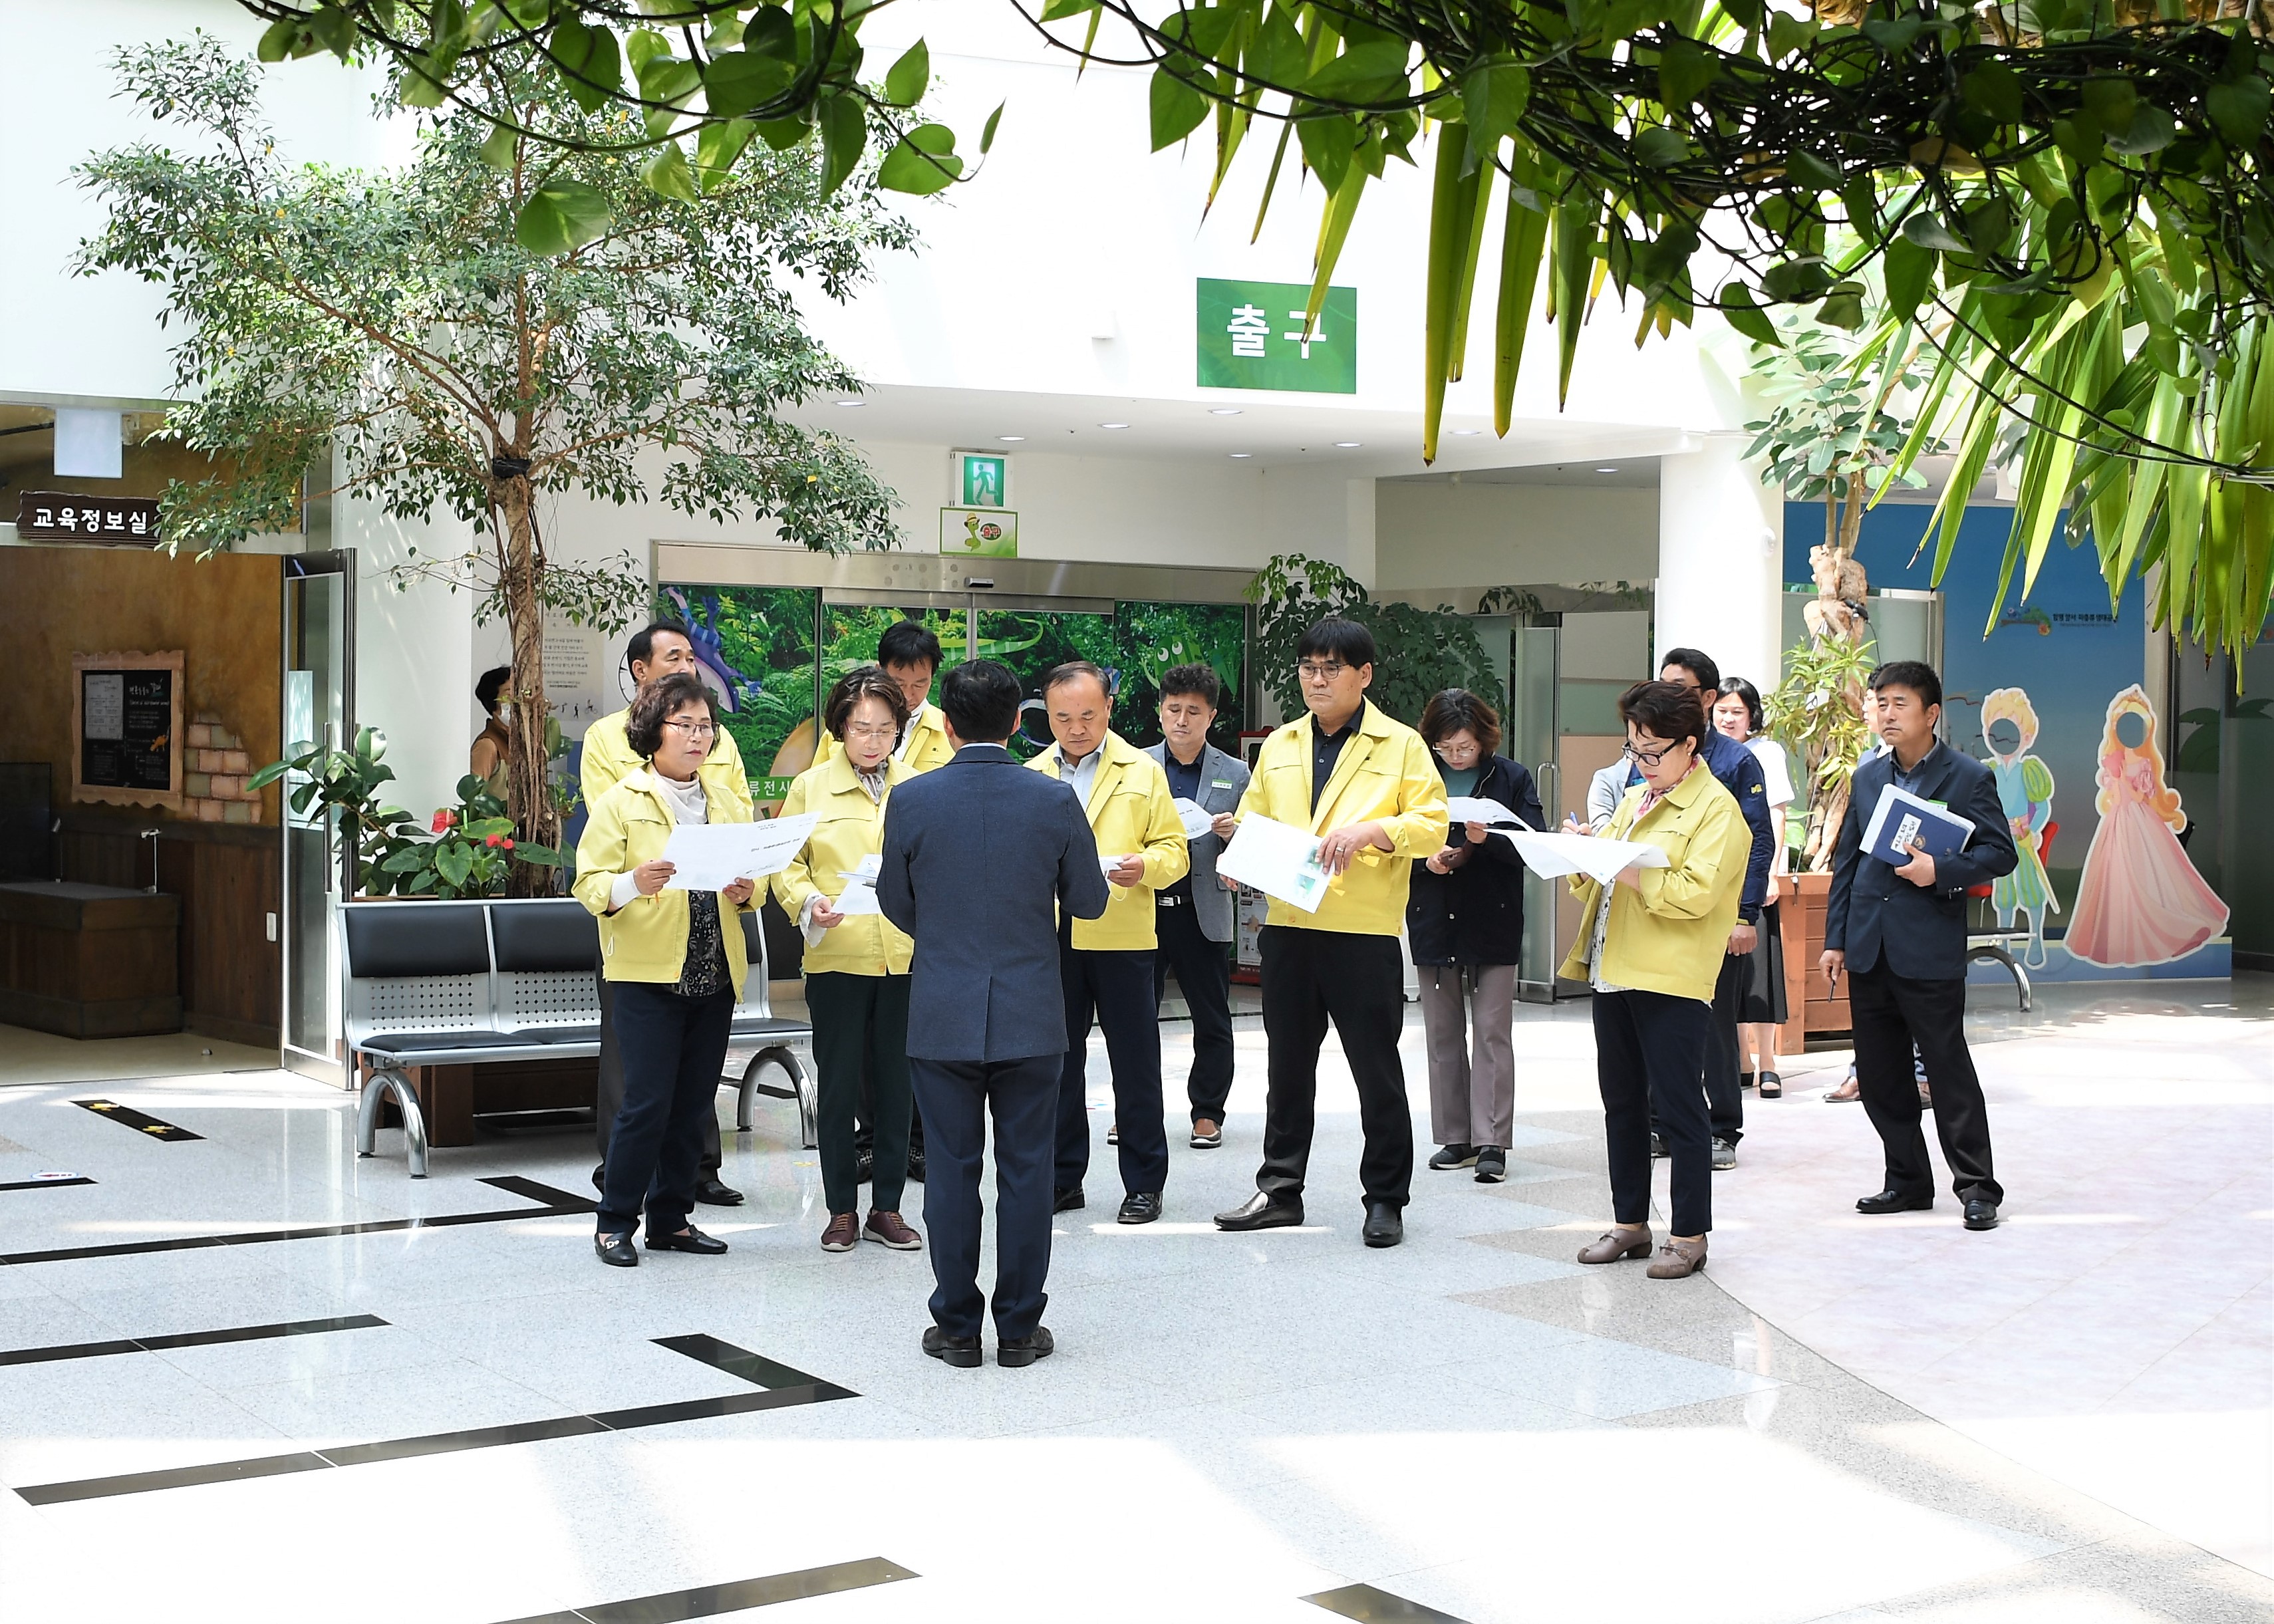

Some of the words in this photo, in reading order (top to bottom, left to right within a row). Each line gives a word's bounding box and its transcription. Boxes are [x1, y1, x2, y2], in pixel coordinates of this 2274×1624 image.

[1226, 303, 1327, 360] 출구
[33, 507, 147, 535] 교육정보실
[982, 525, 1000, 538] 출구
